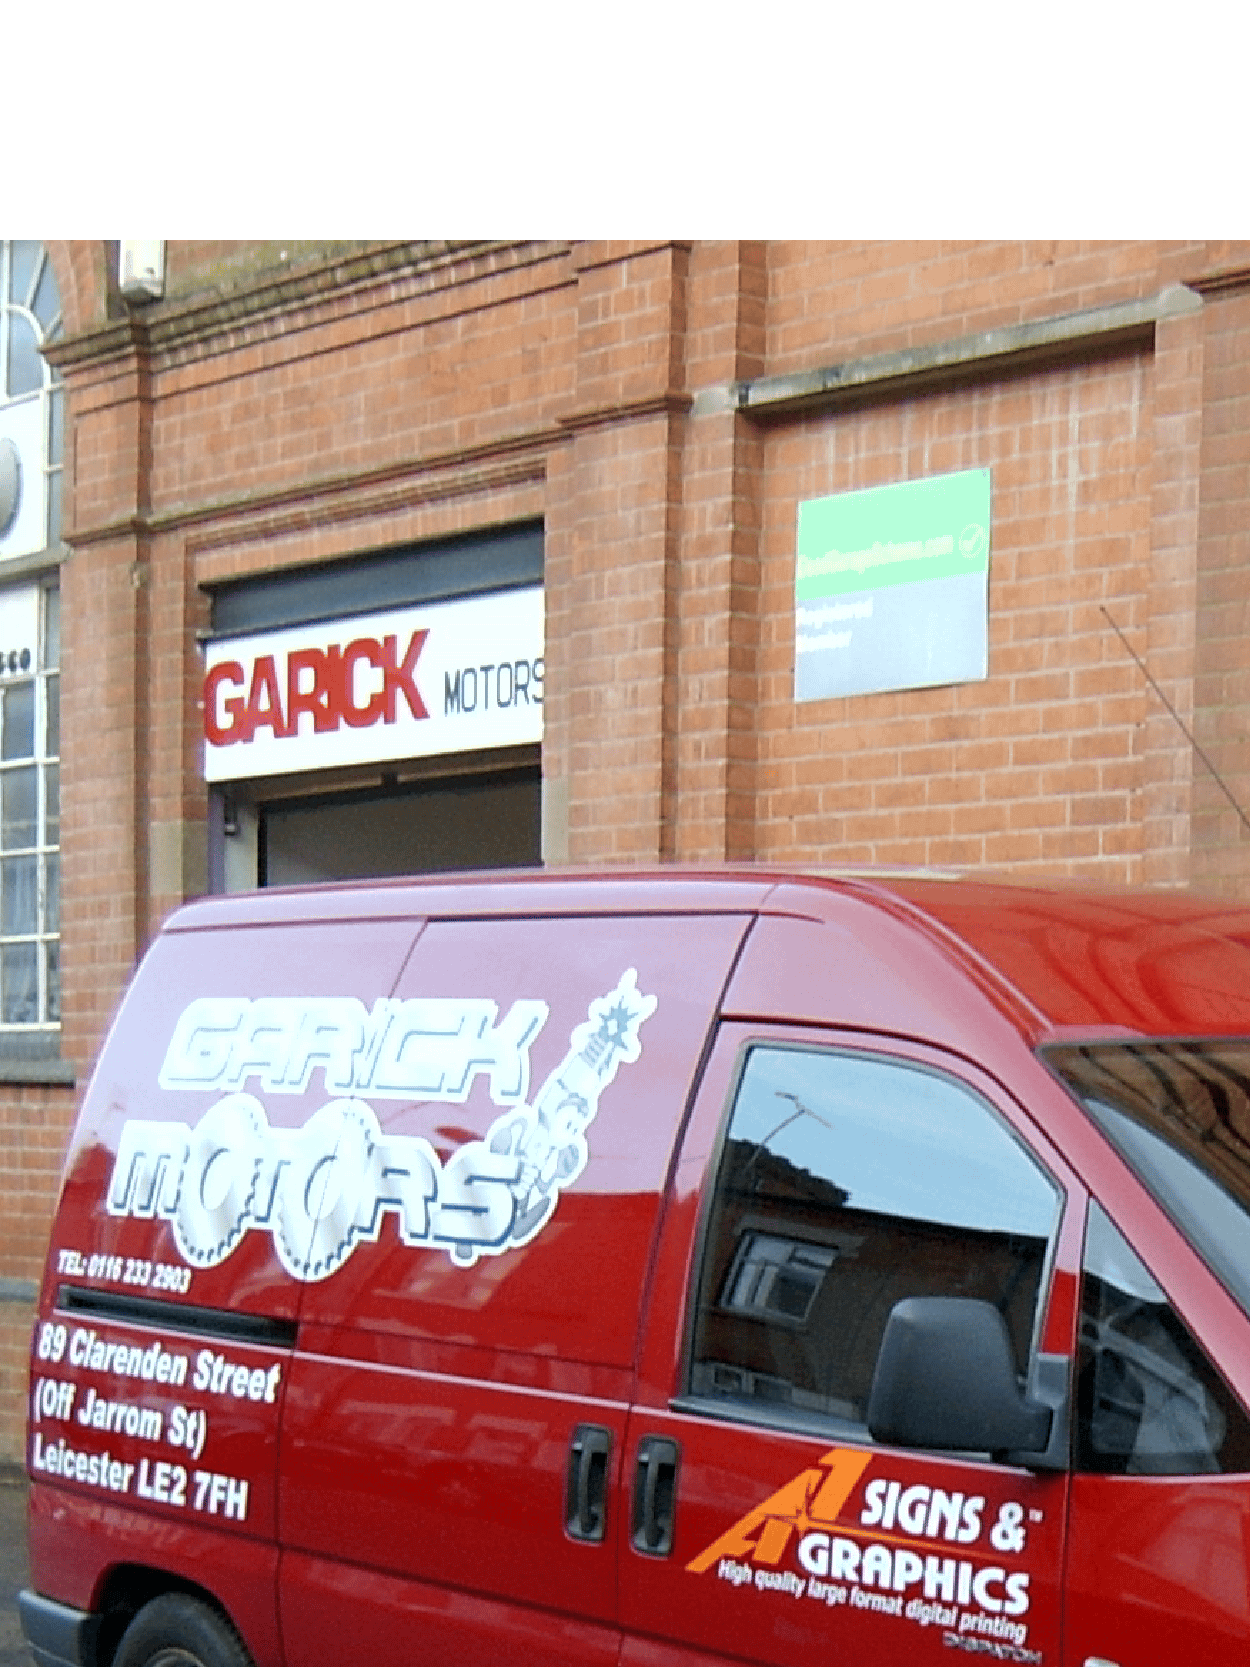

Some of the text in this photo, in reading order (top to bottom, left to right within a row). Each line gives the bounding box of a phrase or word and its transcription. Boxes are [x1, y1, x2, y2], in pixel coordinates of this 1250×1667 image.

[203, 628, 545, 748] GARICK MOTORS
[160, 998, 548, 1104] GARICK
[107, 1093, 525, 1281] MOTORS
[57, 1249, 88, 1276] TEL:
[122, 1257, 152, 1286] 233
[38, 1322, 281, 1404] 89 Clarenden Street
[34, 1377, 208, 1460] (Off Jarrom St)
[32, 1432, 249, 1521] Leicester LE2 7FH
[860, 1478, 1027, 1554] SIGNS &
[718, 1558, 1028, 1646] High quality large format digital printing
[798, 1532, 1031, 1616] GRAPHICS
